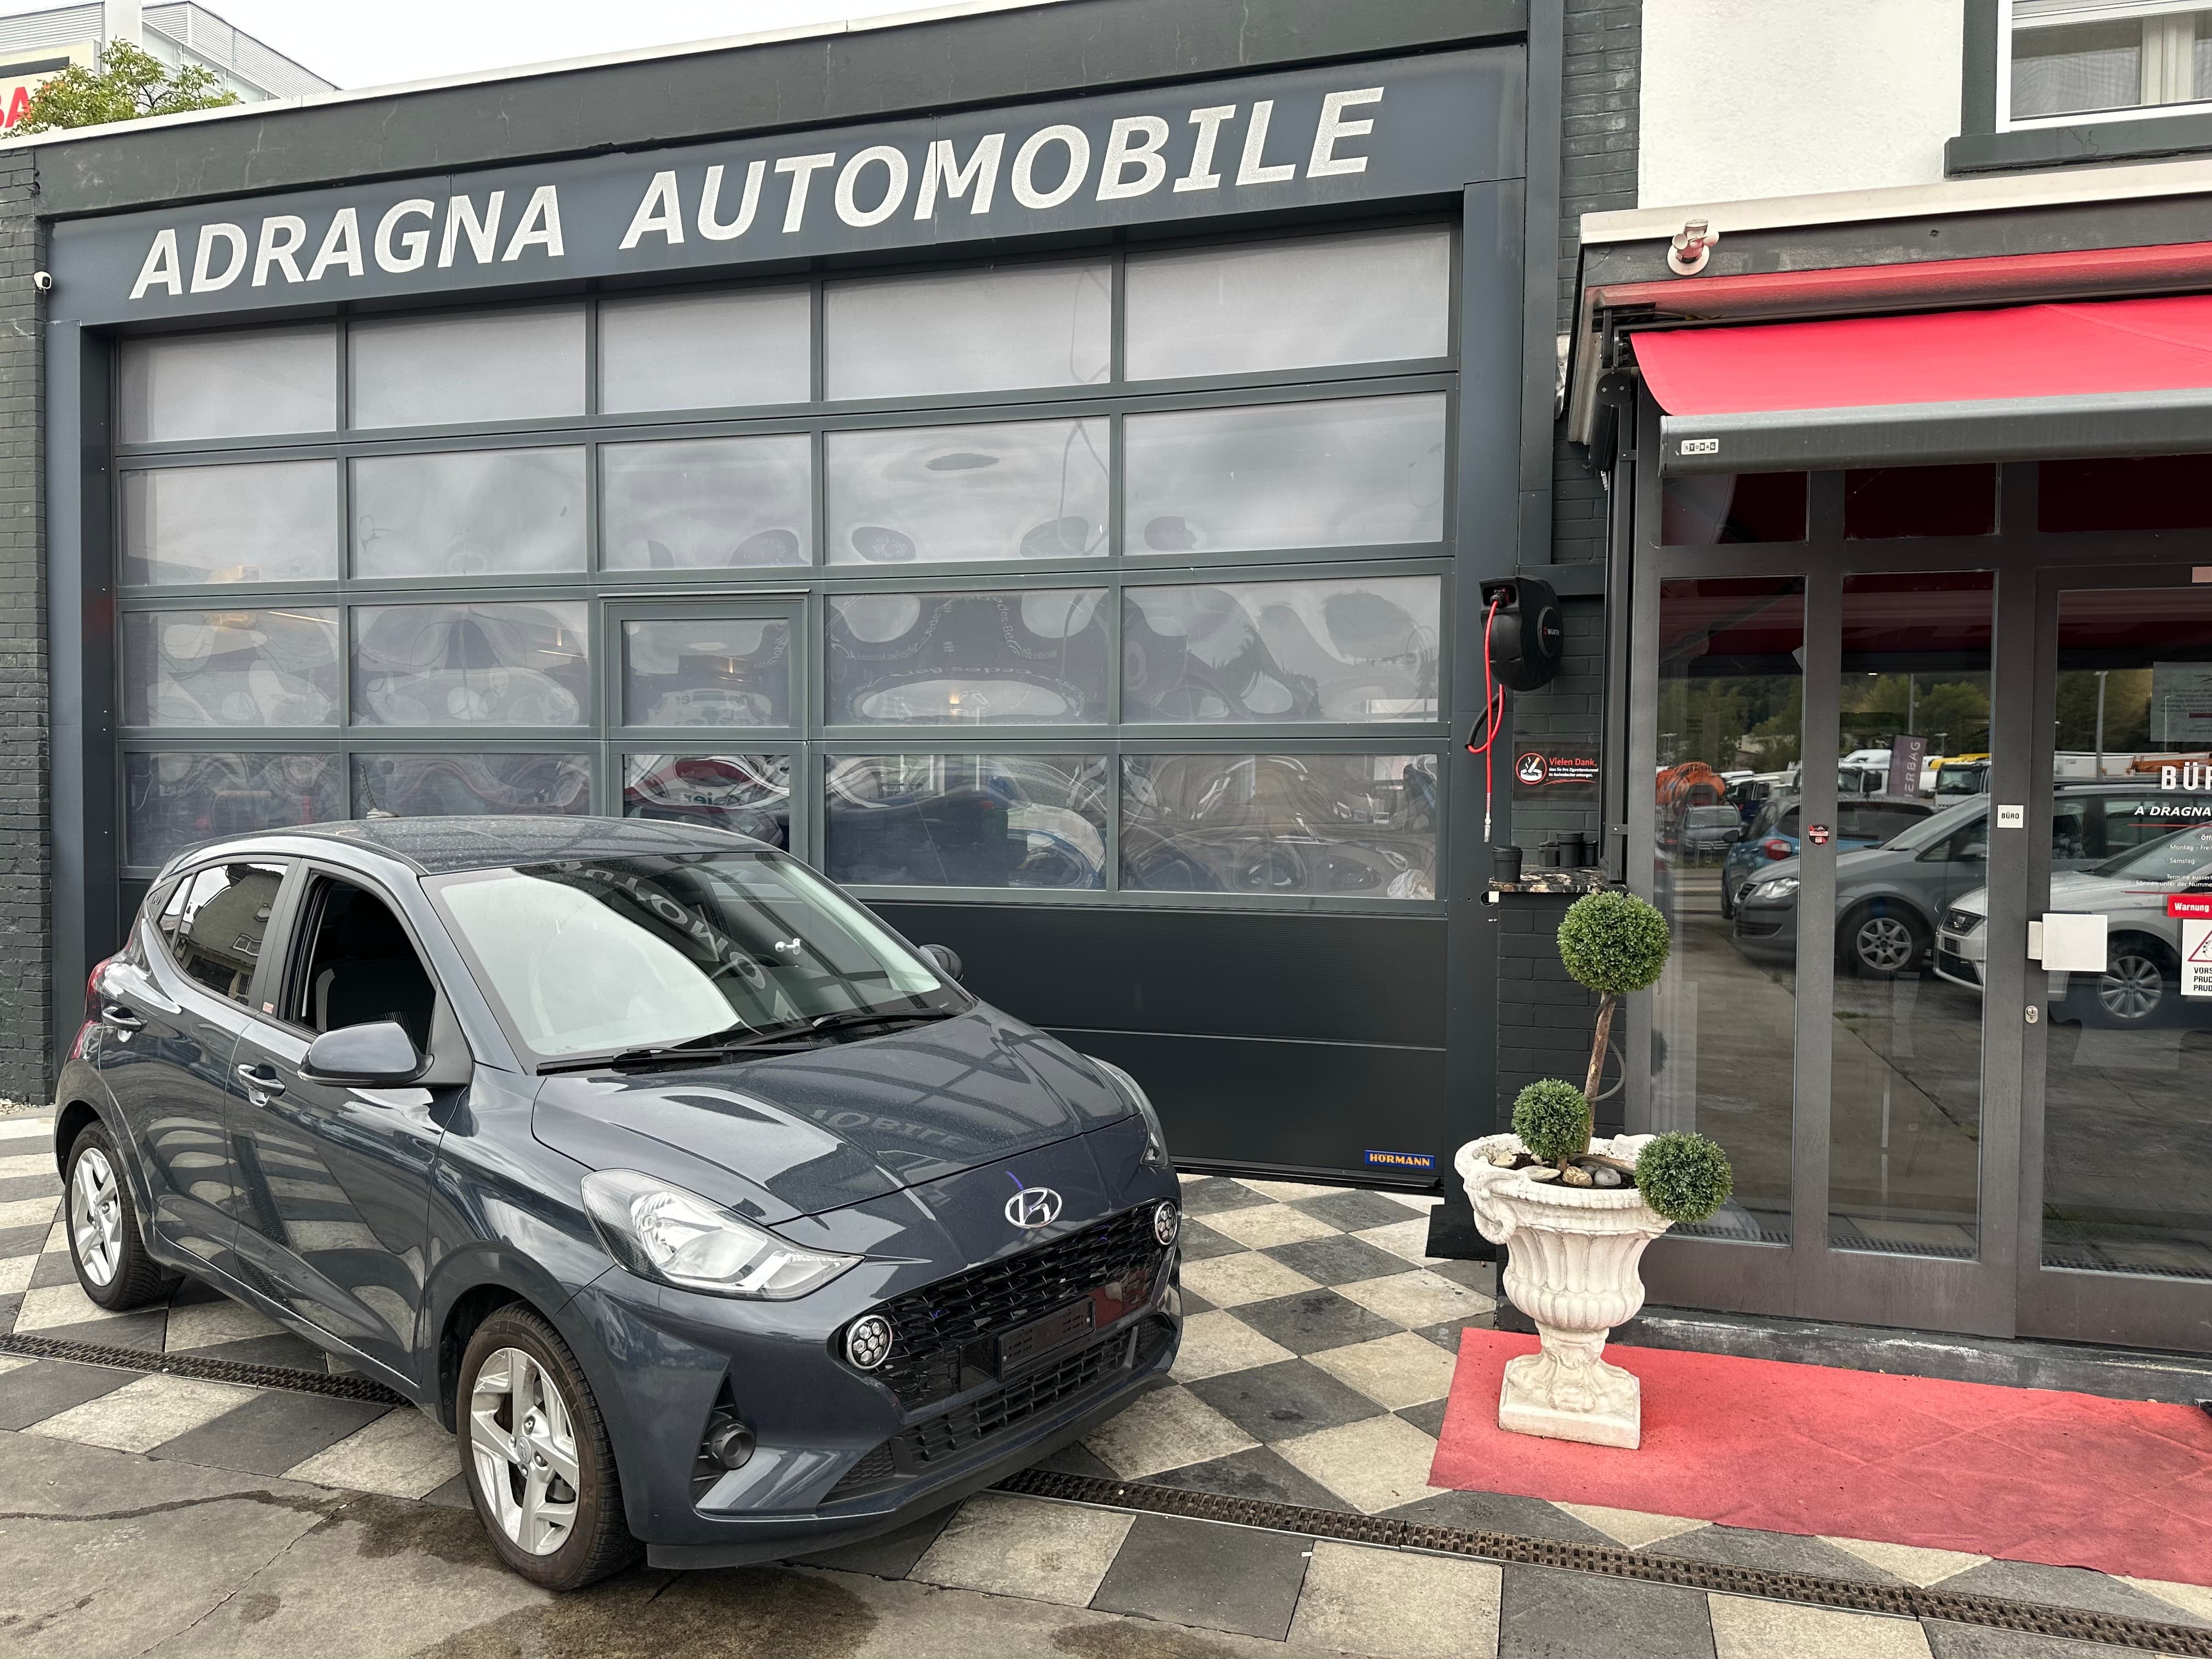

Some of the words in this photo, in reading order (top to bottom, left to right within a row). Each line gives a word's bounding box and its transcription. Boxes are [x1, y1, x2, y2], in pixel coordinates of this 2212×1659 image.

[128, 184, 565, 300] ADRAGNA
[618, 86, 1385, 251] AUTOMOBILE
[1549, 758, 1573, 766] Vielen
[1575, 758, 1598, 768] Dank,
[2149, 806, 2212, 816] DRAGNA
[2174, 902, 2209, 912] Warnung
[1369, 1153, 1430, 1166] HÖRMANN
